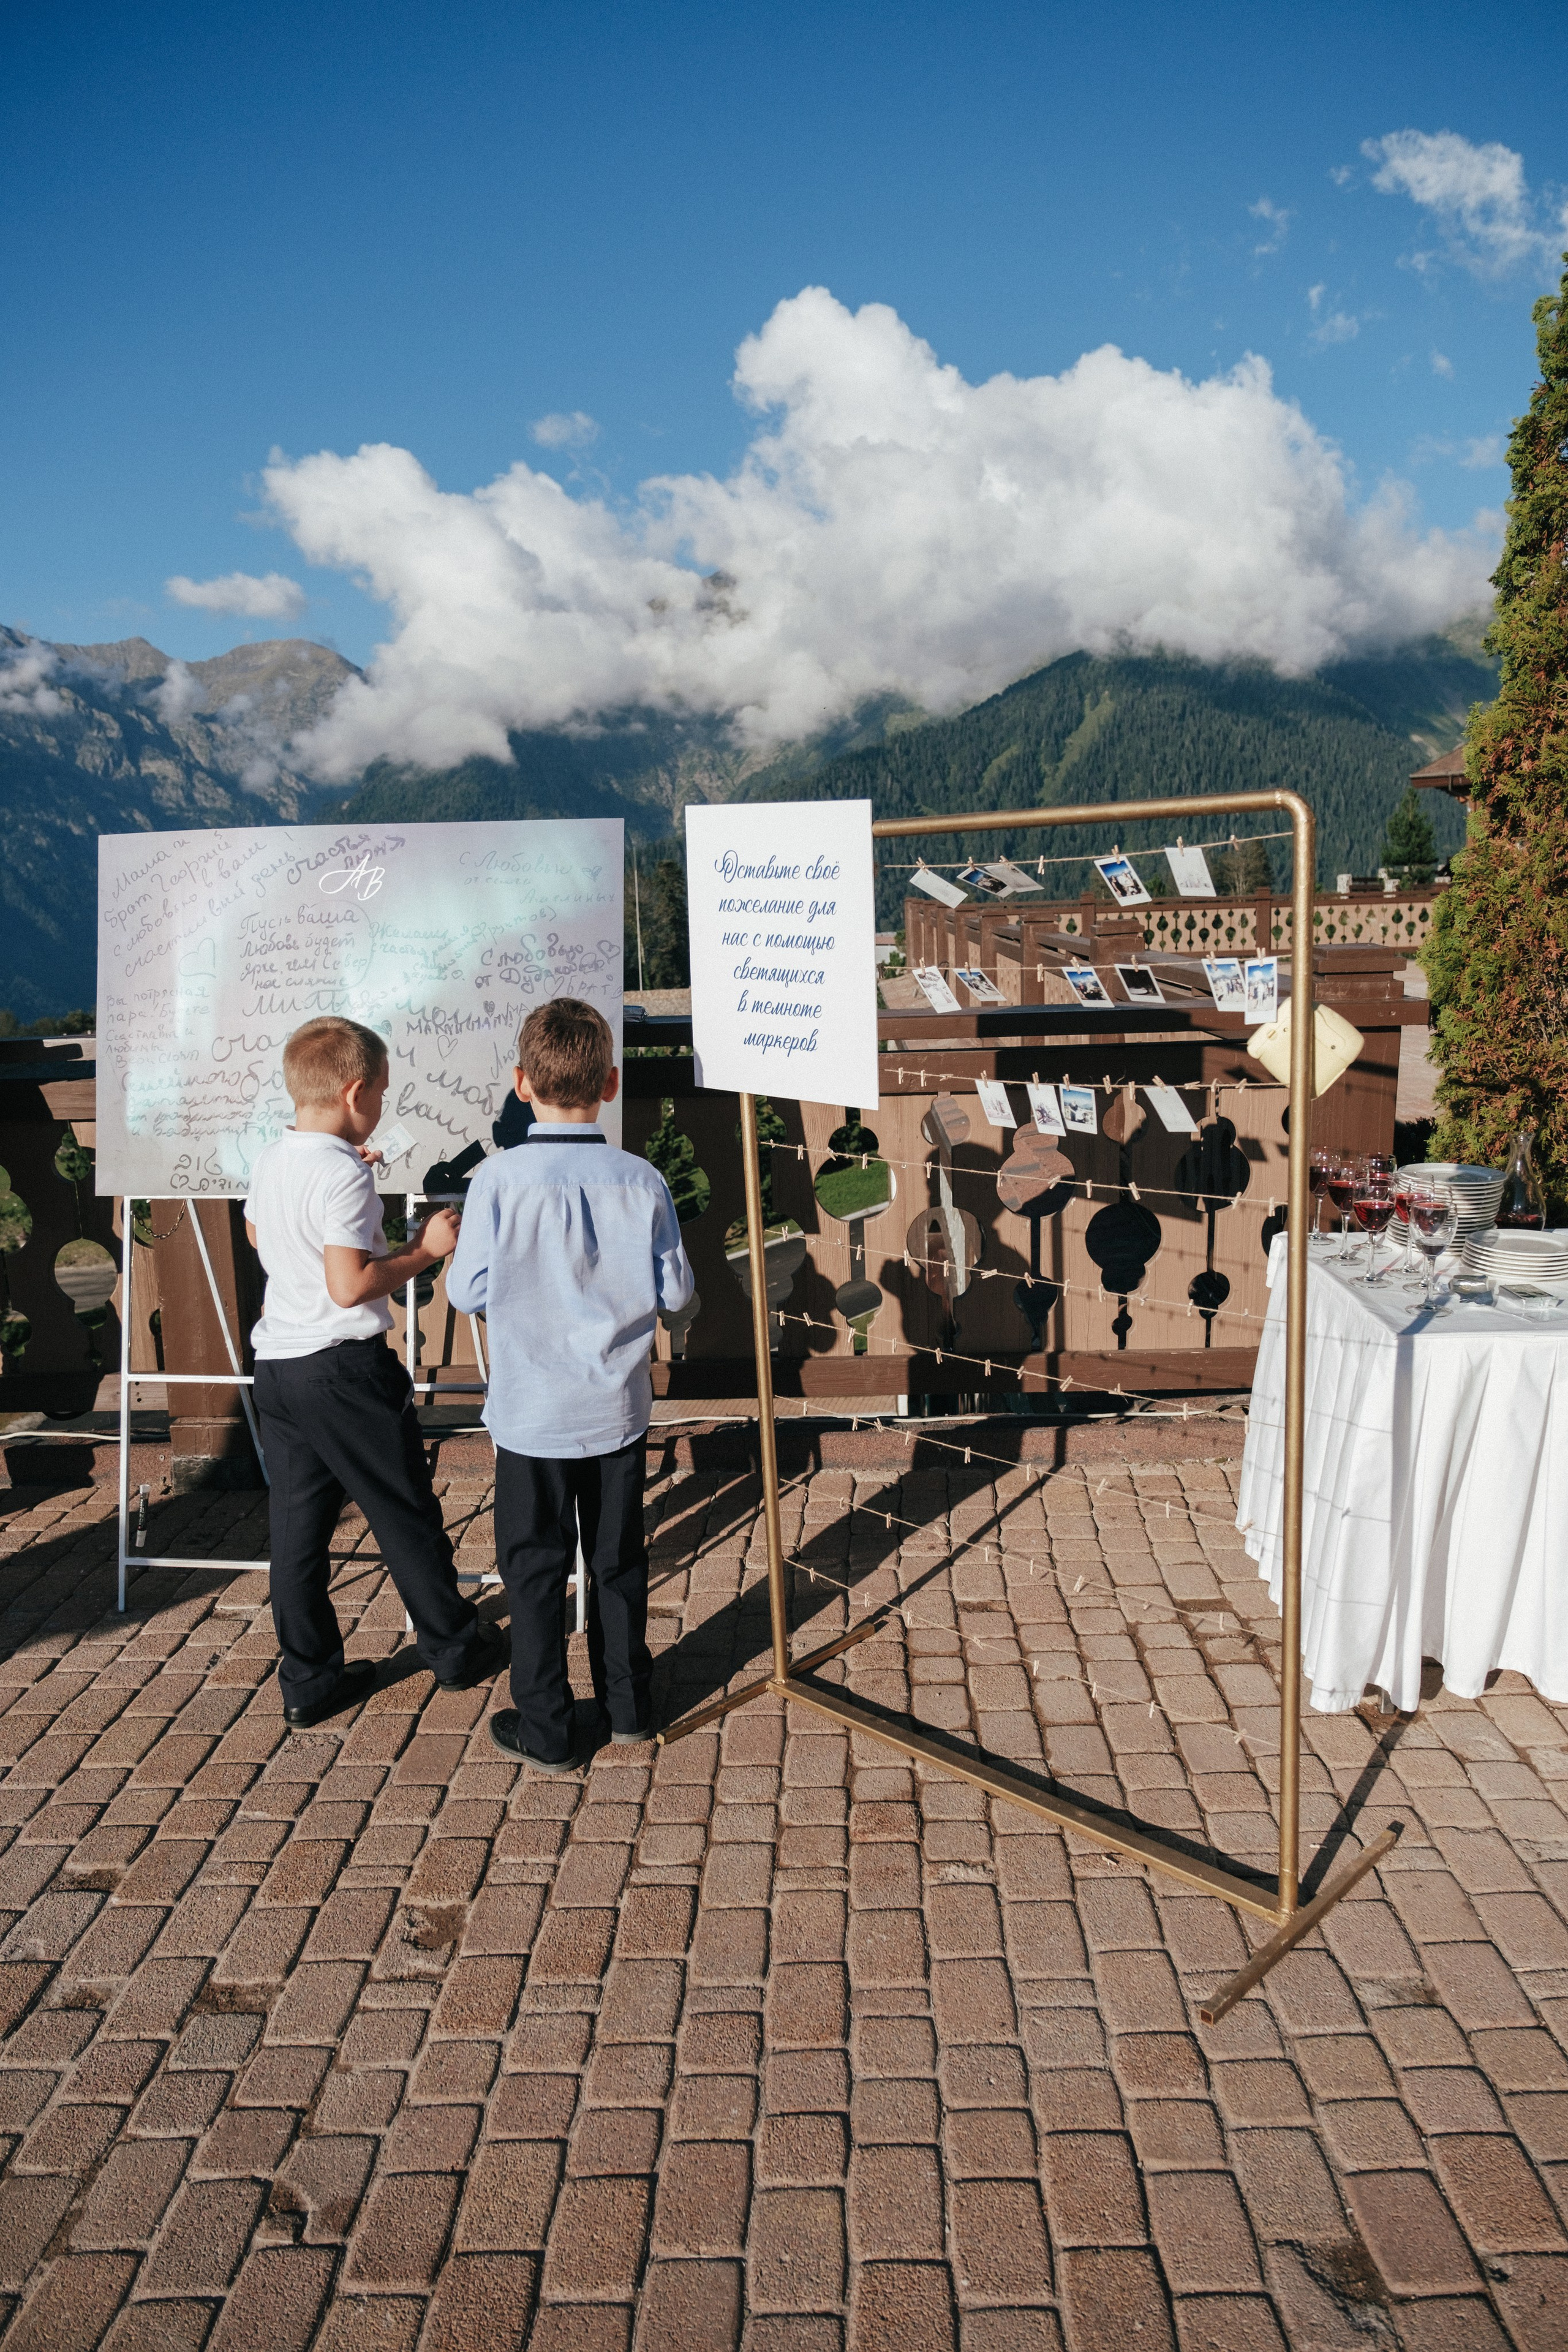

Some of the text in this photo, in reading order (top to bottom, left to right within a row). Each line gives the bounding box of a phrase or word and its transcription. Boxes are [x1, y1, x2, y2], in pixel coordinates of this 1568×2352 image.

[112, 850, 172, 899] Мама
[715, 850, 840, 883] Оставьте своё
[718, 897, 837, 923] пожелание для
[722, 932, 835, 956] нас с помощью
[733, 957, 826, 987] светящихся
[737, 989, 822, 1019] в темноте
[744, 1029, 818, 1058] маркеров
